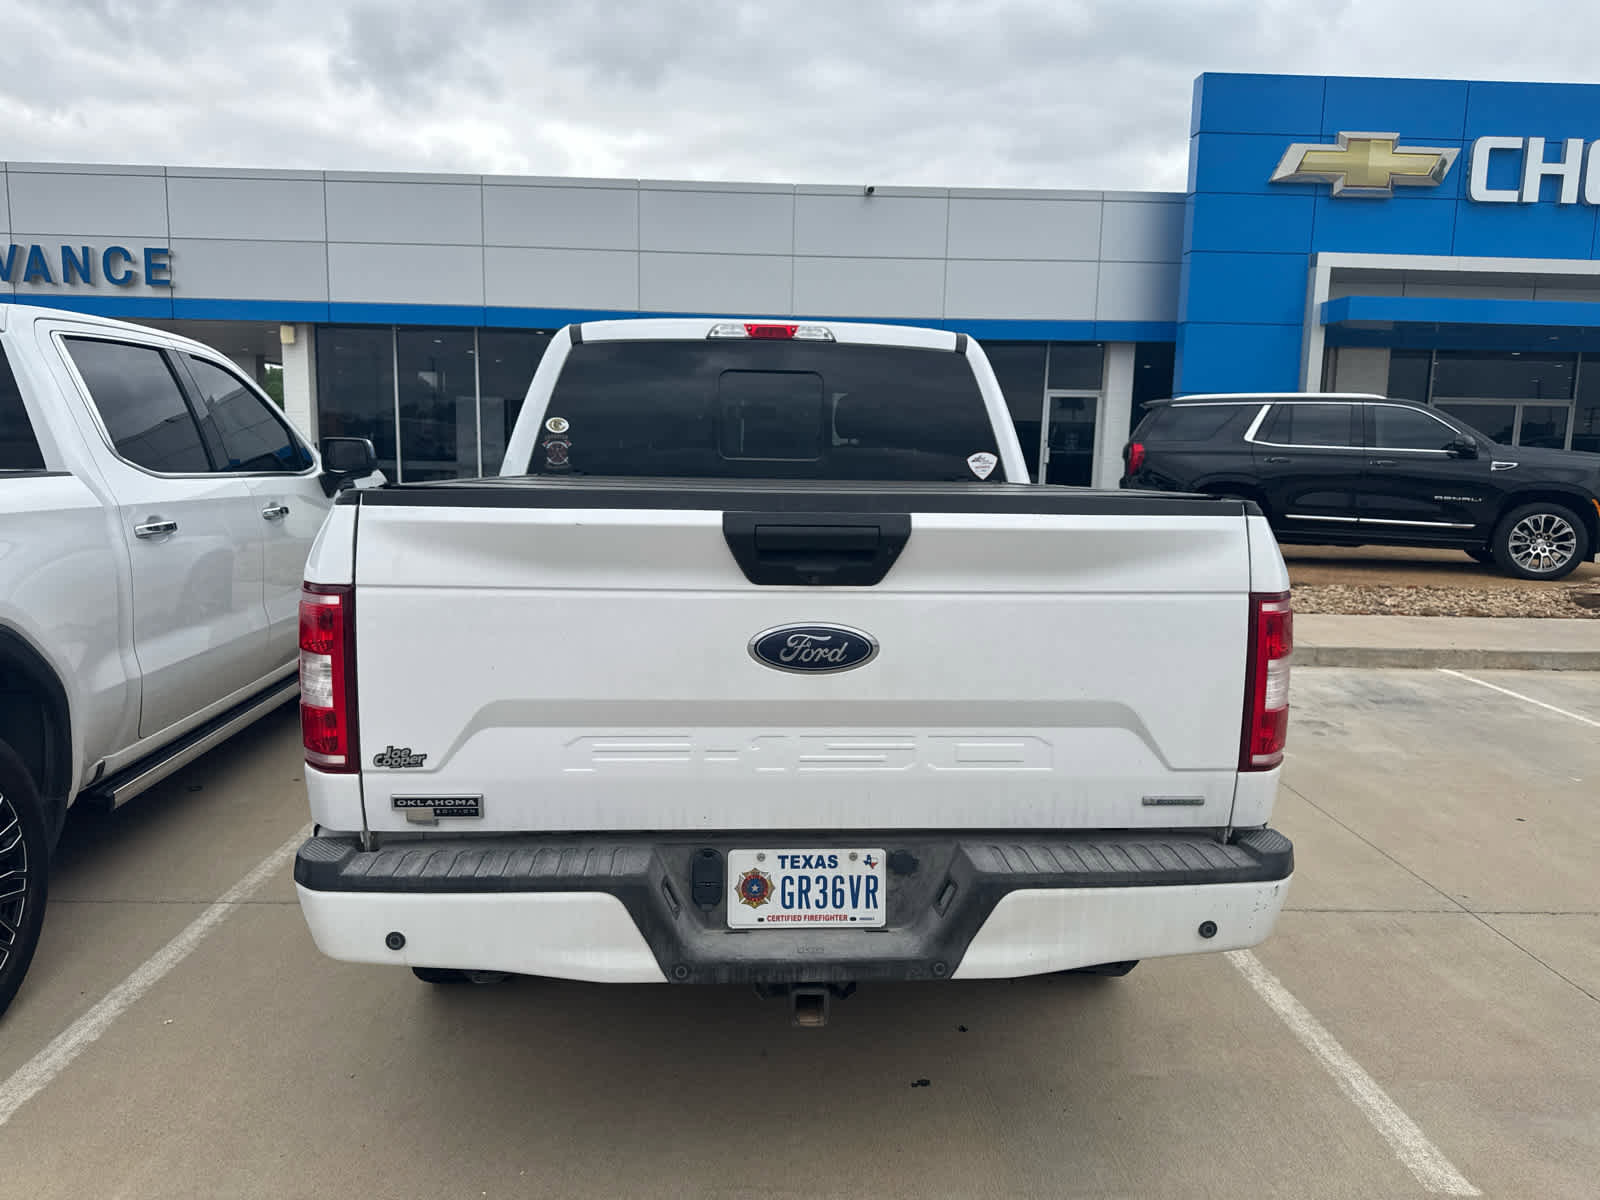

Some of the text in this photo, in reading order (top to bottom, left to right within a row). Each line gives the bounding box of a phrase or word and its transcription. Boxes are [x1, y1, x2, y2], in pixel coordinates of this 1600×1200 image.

[1470, 136, 1600, 205] CH
[779, 633, 849, 662] Ford
[384, 745, 412, 760] Joe
[373, 753, 427, 768] Cooper
[397, 799, 477, 807] OKLAHOMA
[777, 854, 839, 870] TEXAS
[780, 874, 879, 910] GR36VR
[766, 914, 849, 922] CERTIFIED FIREFIGHTER
